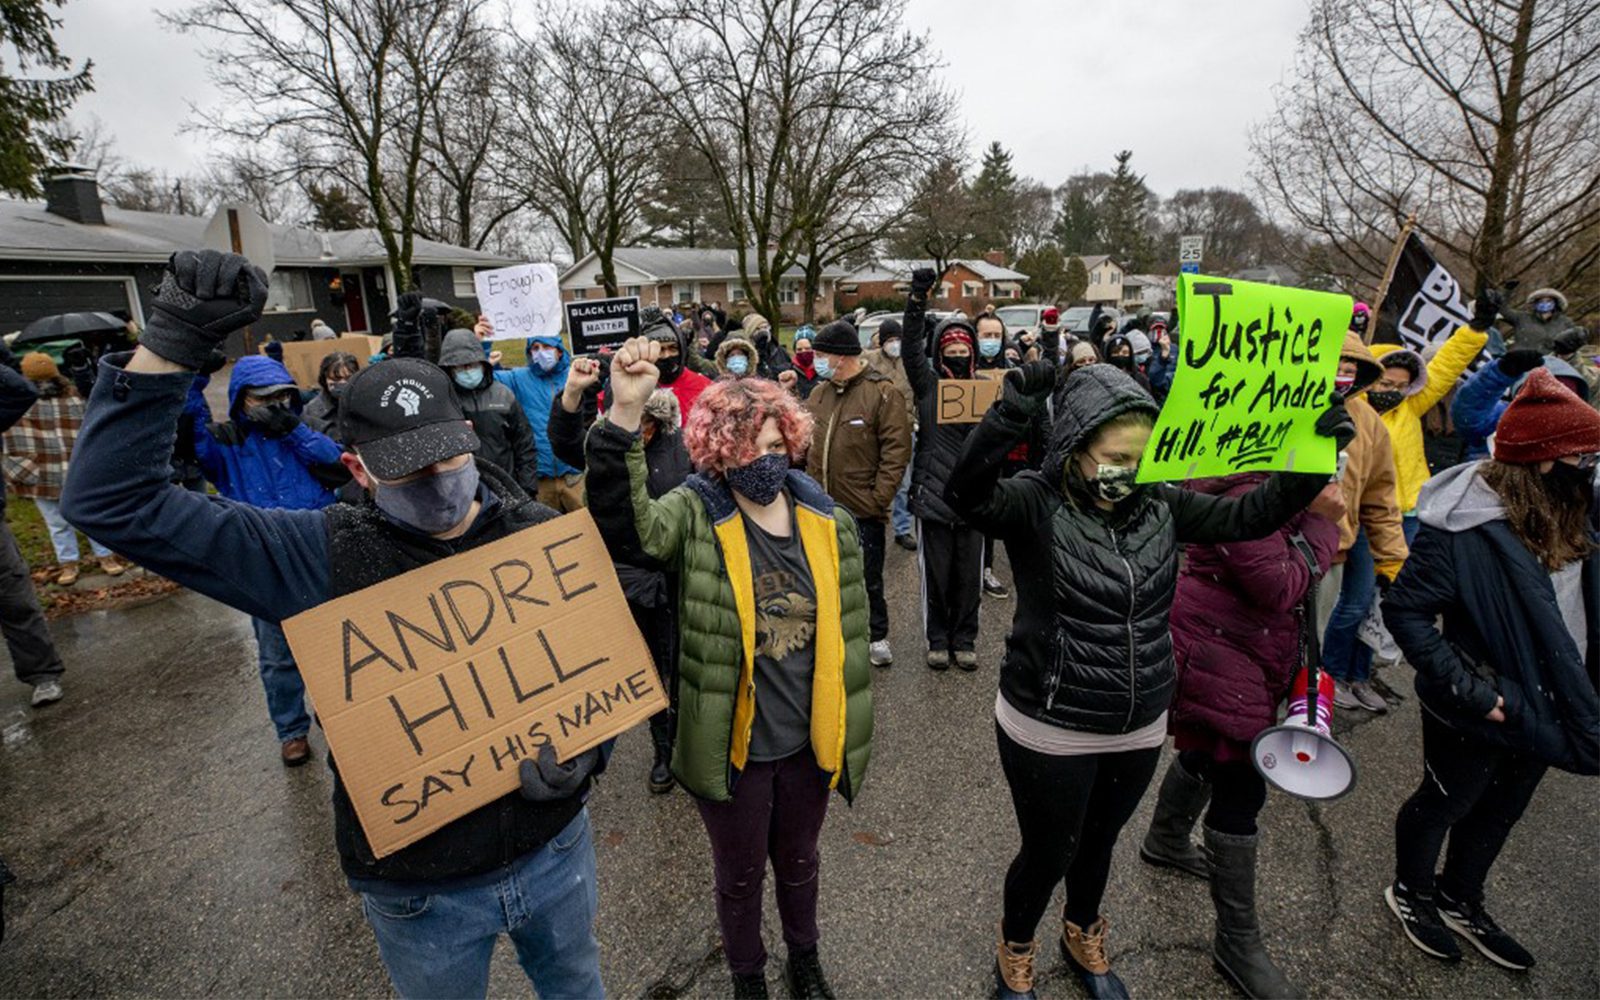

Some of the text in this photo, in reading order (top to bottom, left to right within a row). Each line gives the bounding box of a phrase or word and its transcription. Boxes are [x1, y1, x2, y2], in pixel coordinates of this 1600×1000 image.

[1182, 249, 1201, 260] 25
[488, 268, 543, 296] Enough
[571, 303, 636, 317] BLACK LIVES
[586, 321, 624, 332] MATTER
[1185, 282, 1322, 368] Justice
[380, 378, 434, 407] GOOD TROUBLE
[1200, 370, 1327, 413] for Andre
[1216, 419, 1294, 458] #BLM
[340, 532, 598, 702] ANDRE
[387, 629, 611, 757] HILL
[380, 669, 654, 825] SAY HIS NAME
